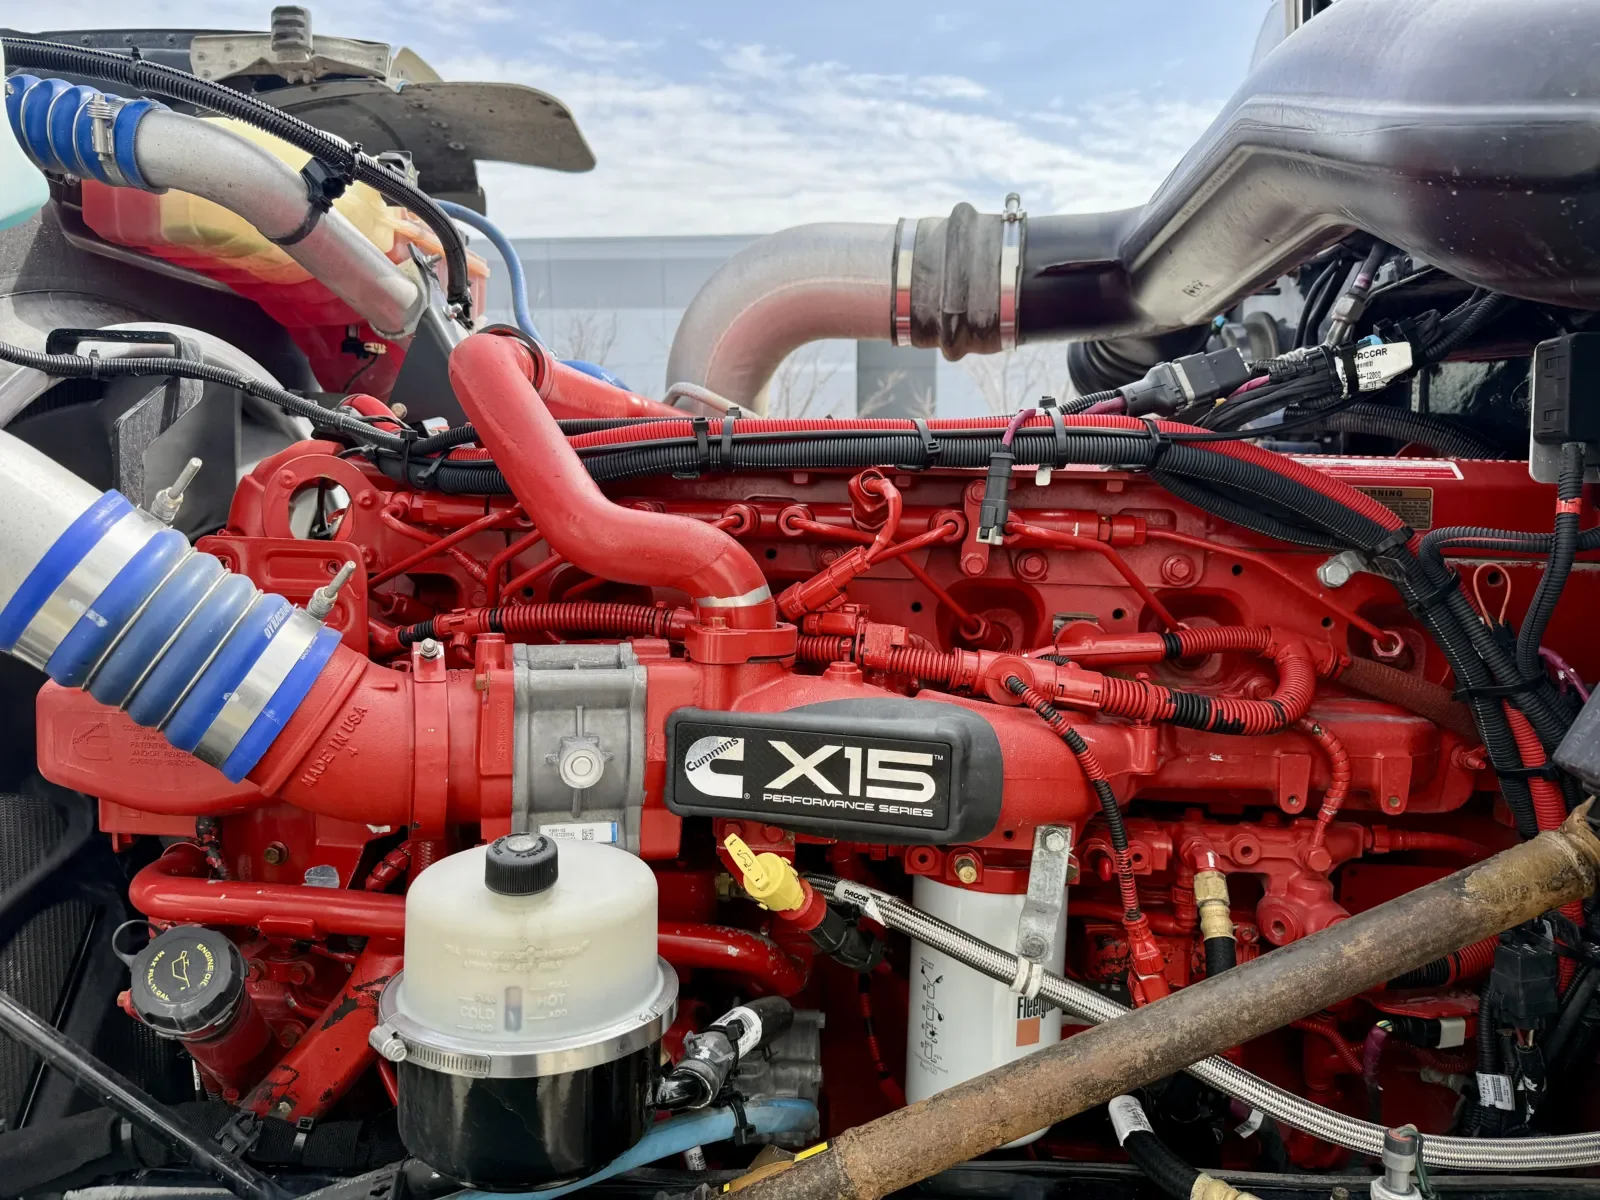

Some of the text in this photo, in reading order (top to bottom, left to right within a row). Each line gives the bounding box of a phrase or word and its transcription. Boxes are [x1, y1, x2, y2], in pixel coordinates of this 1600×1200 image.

[1356, 348, 1388, 361] ACCAR
[1361, 489, 1403, 498] ARNING
[301, 706, 368, 787] MADE IN USA
[685, 734, 739, 772] Cummins
[764, 740, 936, 804] X15
[763, 793, 934, 818] PERFORMANCE SERIES
[151, 950, 165, 967] MAX
[196, 943, 214, 987] ENGINE OIL
[537, 993, 567, 1007] HOT
[460, 1005, 496, 1020] COLD
[549, 1008, 568, 1018] ADD
[475, 1023, 494, 1032] ADD
